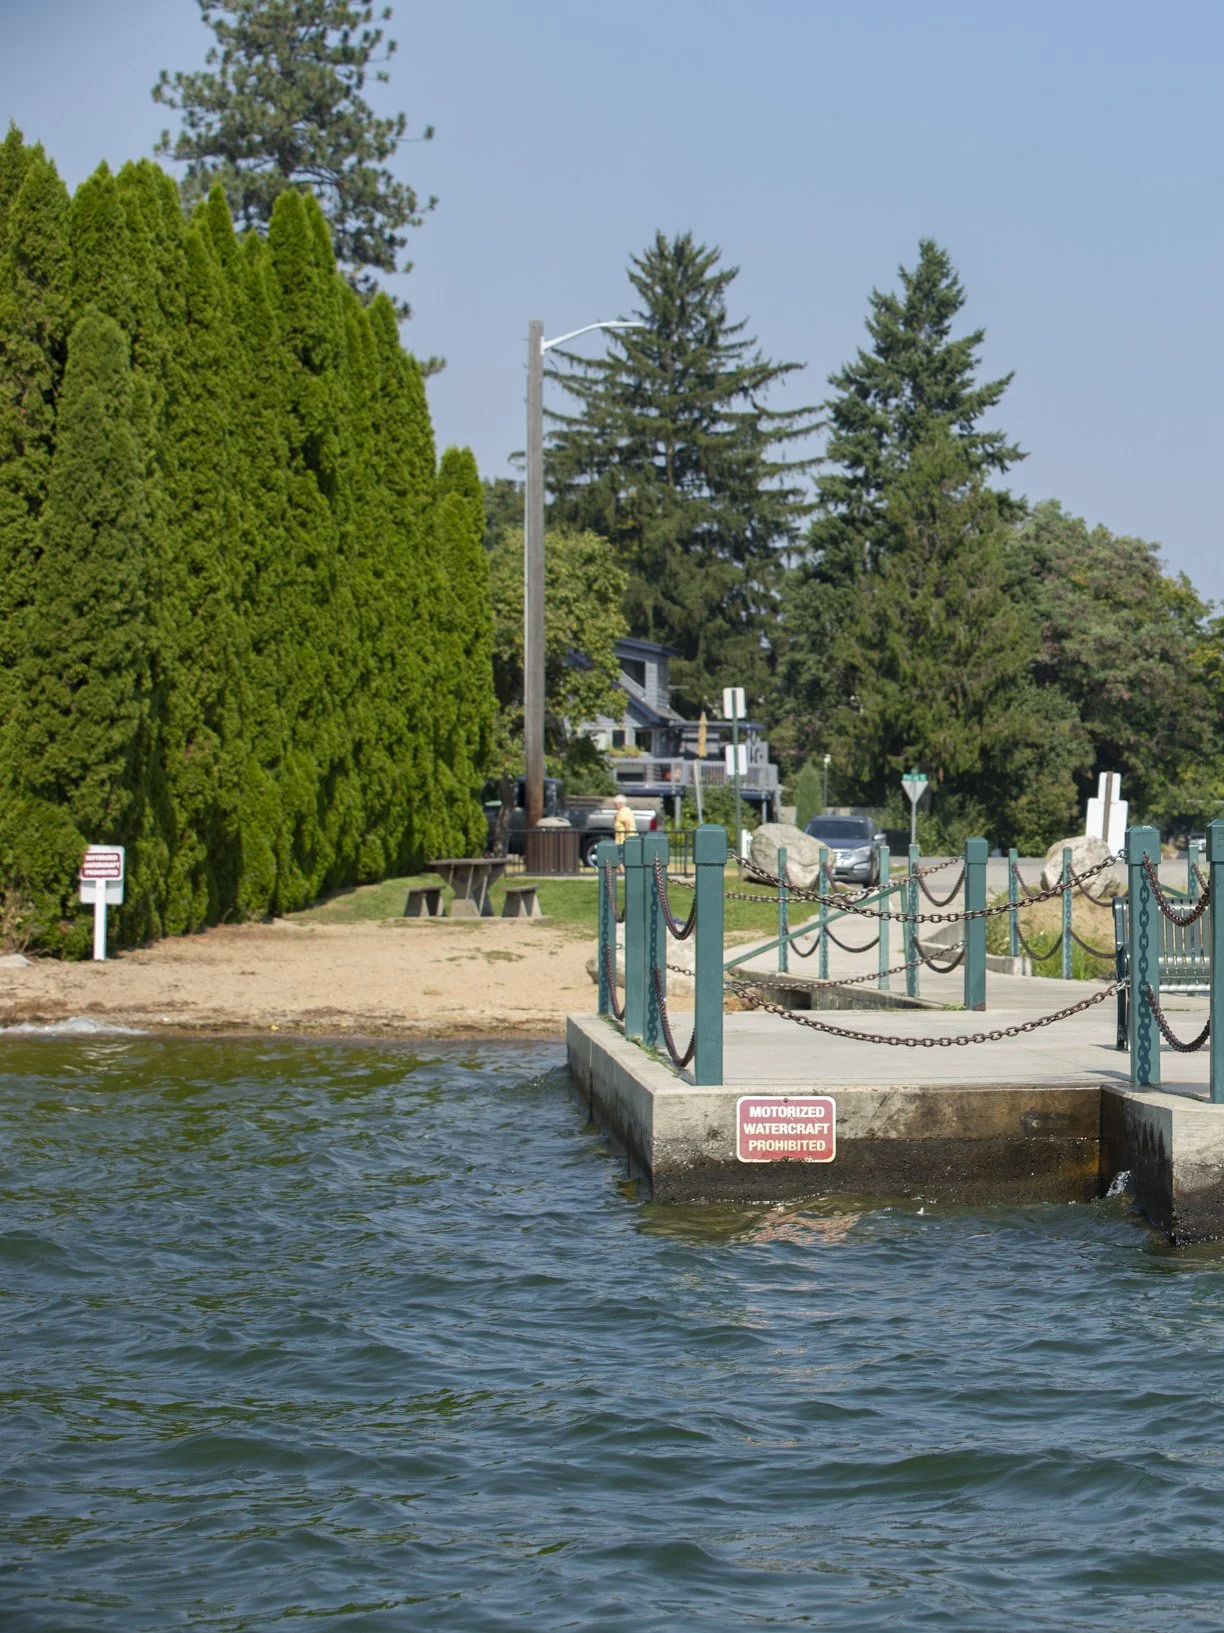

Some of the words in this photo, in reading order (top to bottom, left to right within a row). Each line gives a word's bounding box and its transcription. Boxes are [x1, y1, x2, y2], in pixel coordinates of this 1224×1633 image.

[749, 1106, 825, 1118] MOTORIZED
[743, 1123, 830, 1135] WATERCRAFT
[748, 1140, 826, 1151] PROHIBITED
